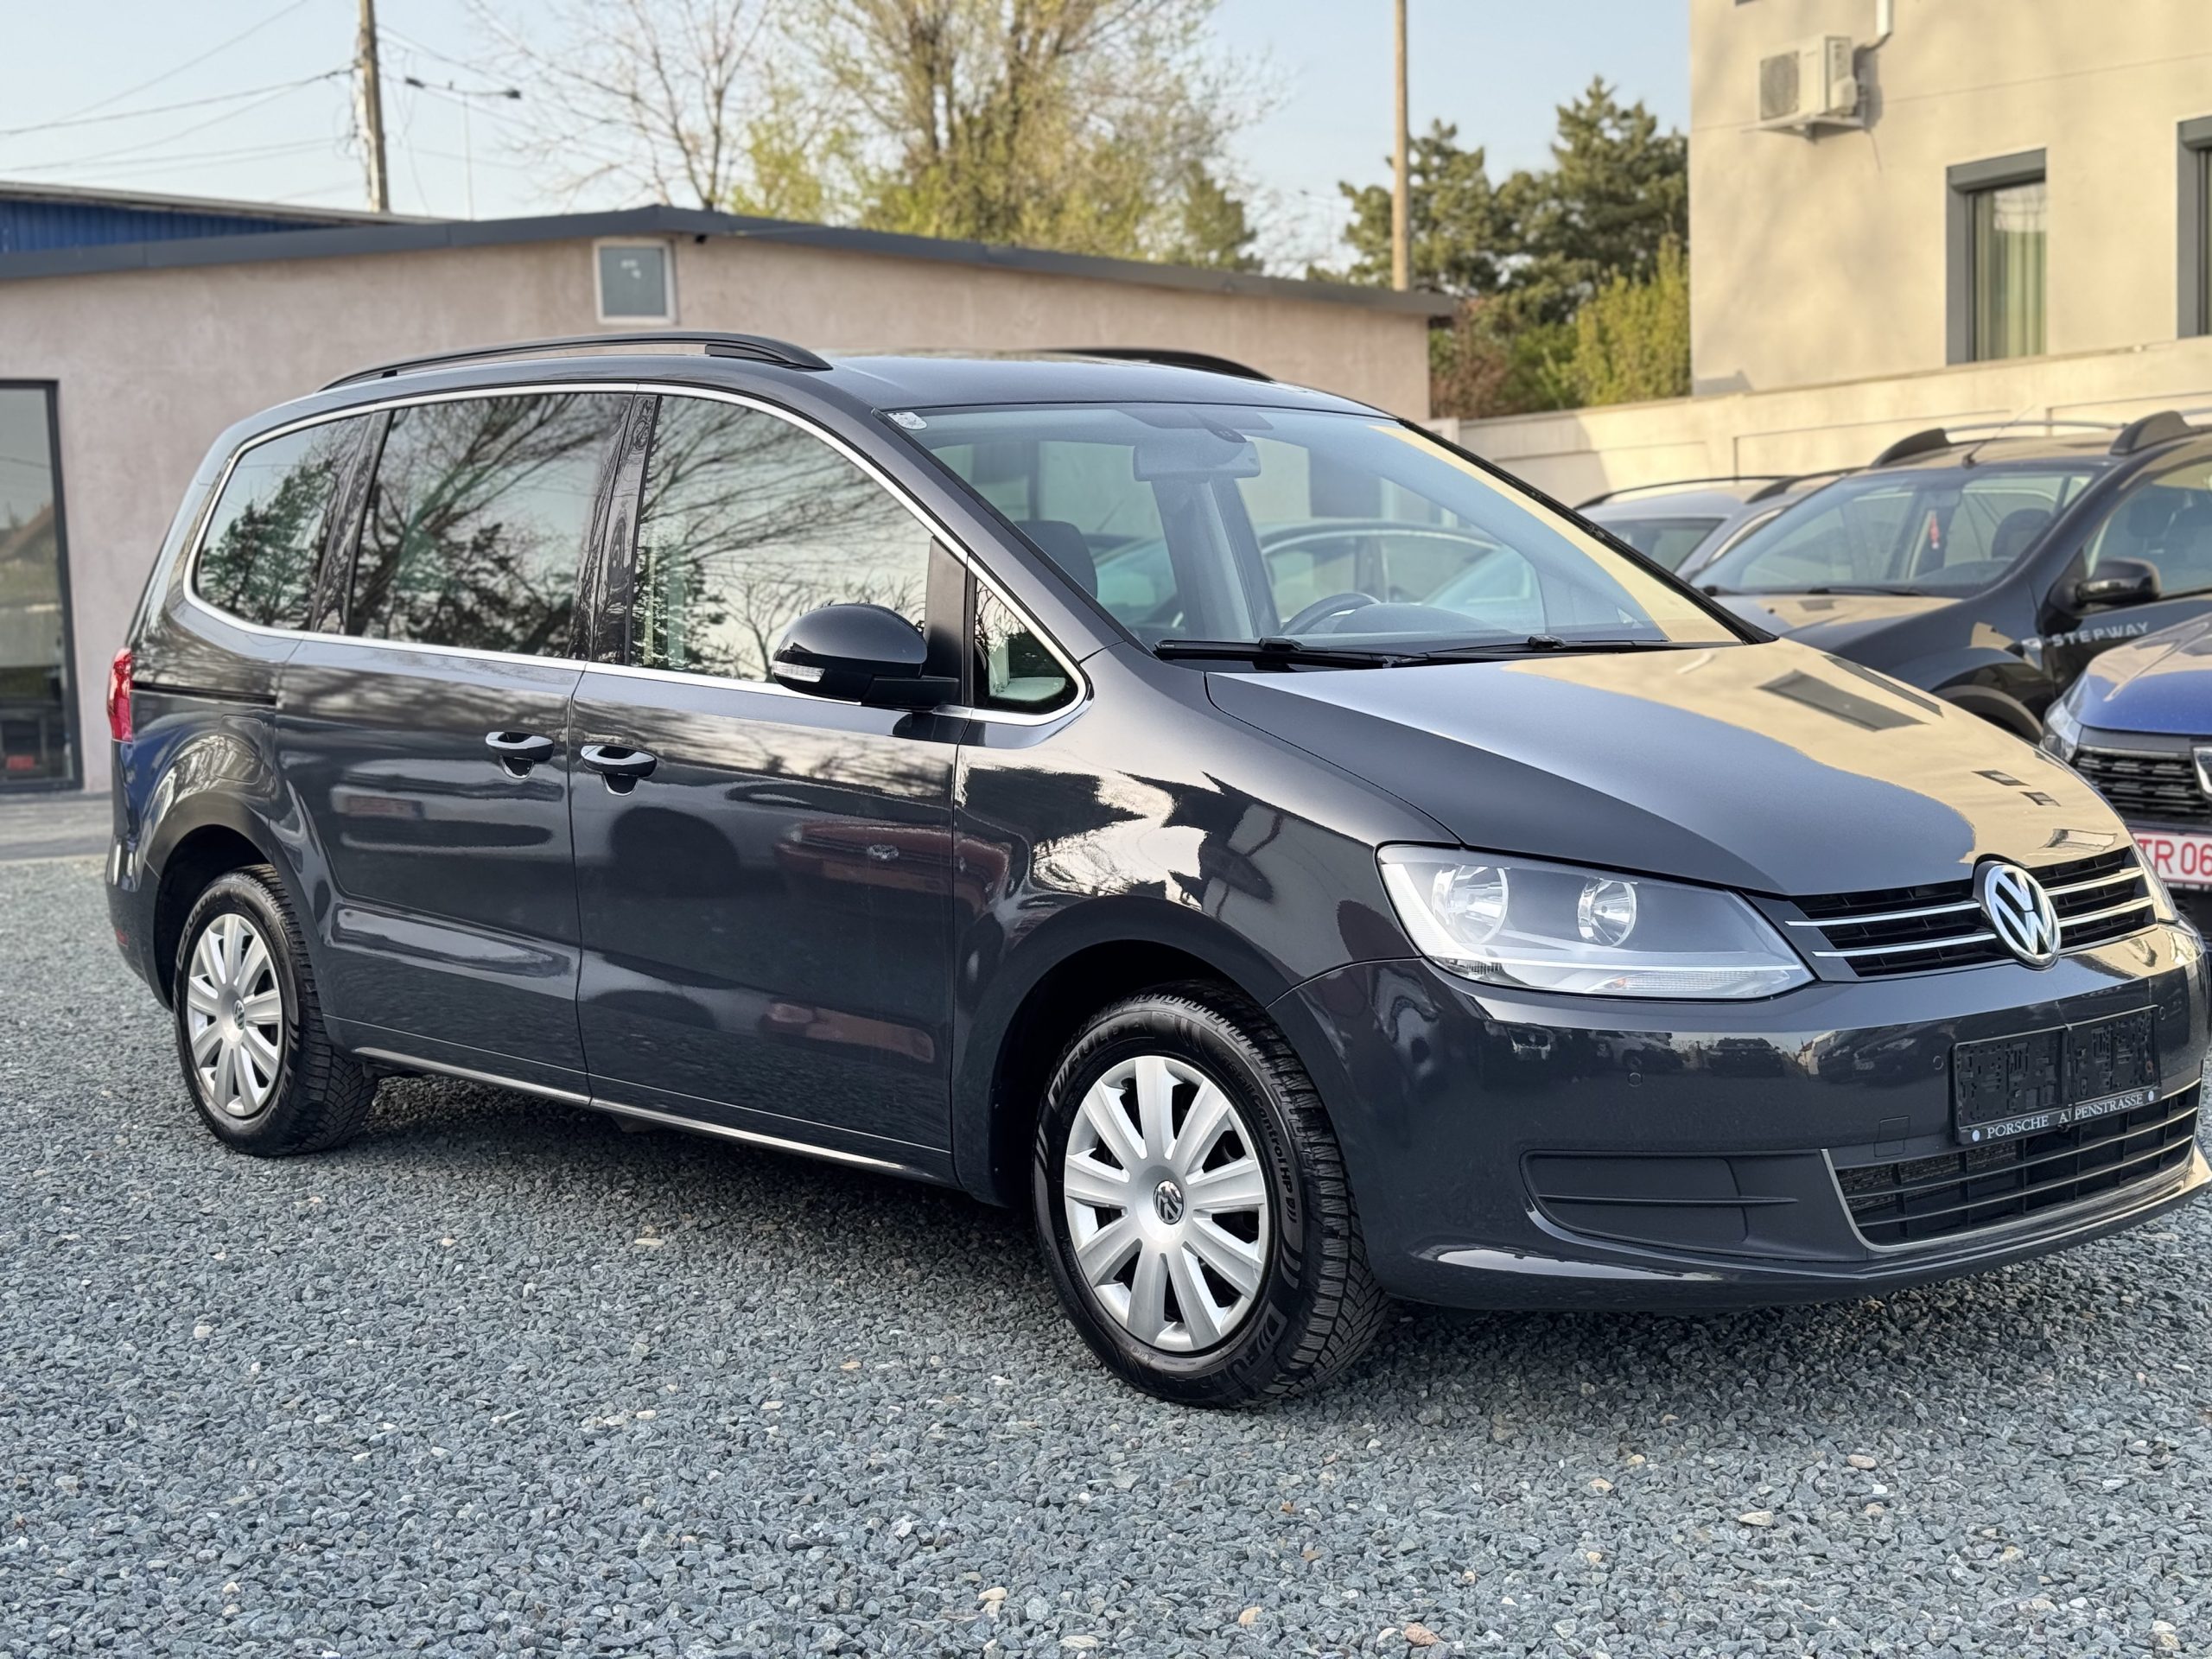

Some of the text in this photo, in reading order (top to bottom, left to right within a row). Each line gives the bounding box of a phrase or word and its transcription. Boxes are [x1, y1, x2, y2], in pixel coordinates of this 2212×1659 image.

[2050, 621, 2149, 647] STEPWAY
[2180, 842, 2212, 877] 06
[1986, 1115, 2050, 1140] PORSCHE
[1253, 1093, 1287, 1164] Control
[1280, 1166, 1294, 1193] HP
